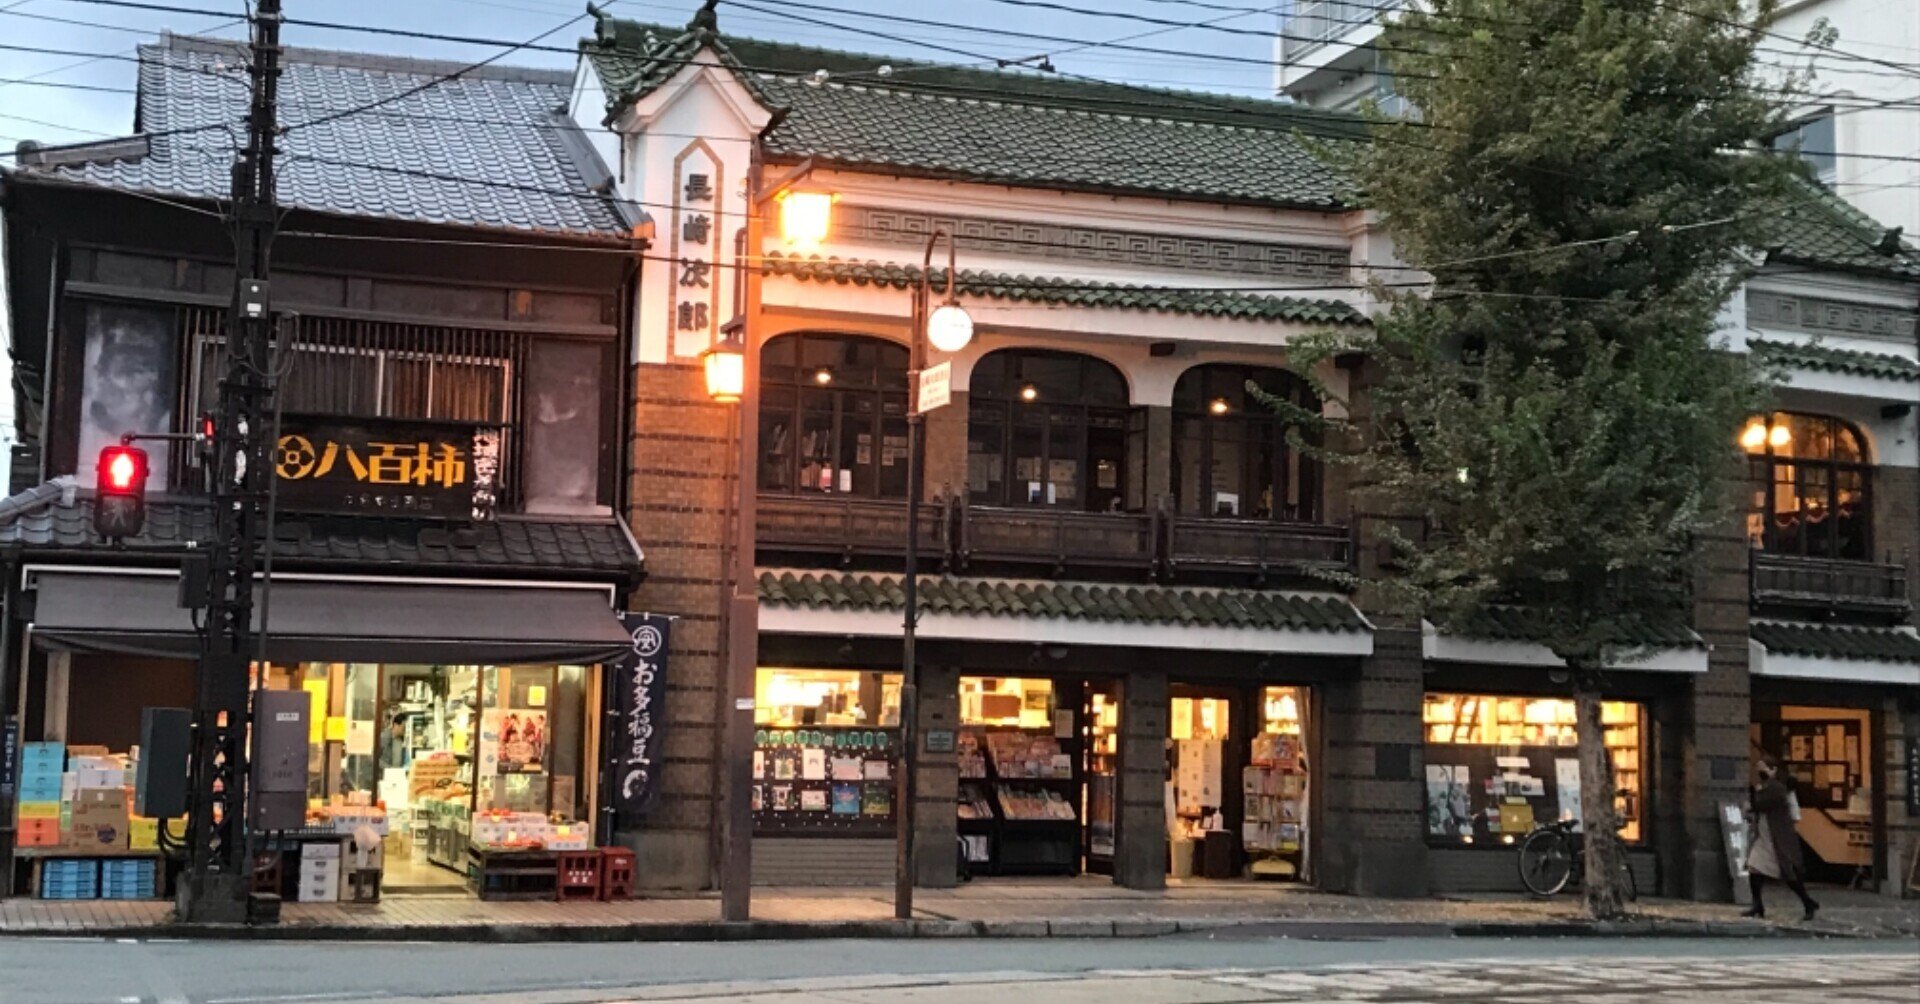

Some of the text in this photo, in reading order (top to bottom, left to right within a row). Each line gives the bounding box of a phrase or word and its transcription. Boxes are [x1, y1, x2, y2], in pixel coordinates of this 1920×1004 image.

[678, 173, 713, 331] 長崎次郎
[313, 441, 466, 489] 八百柿
[627, 659, 658, 766] お多福豆
